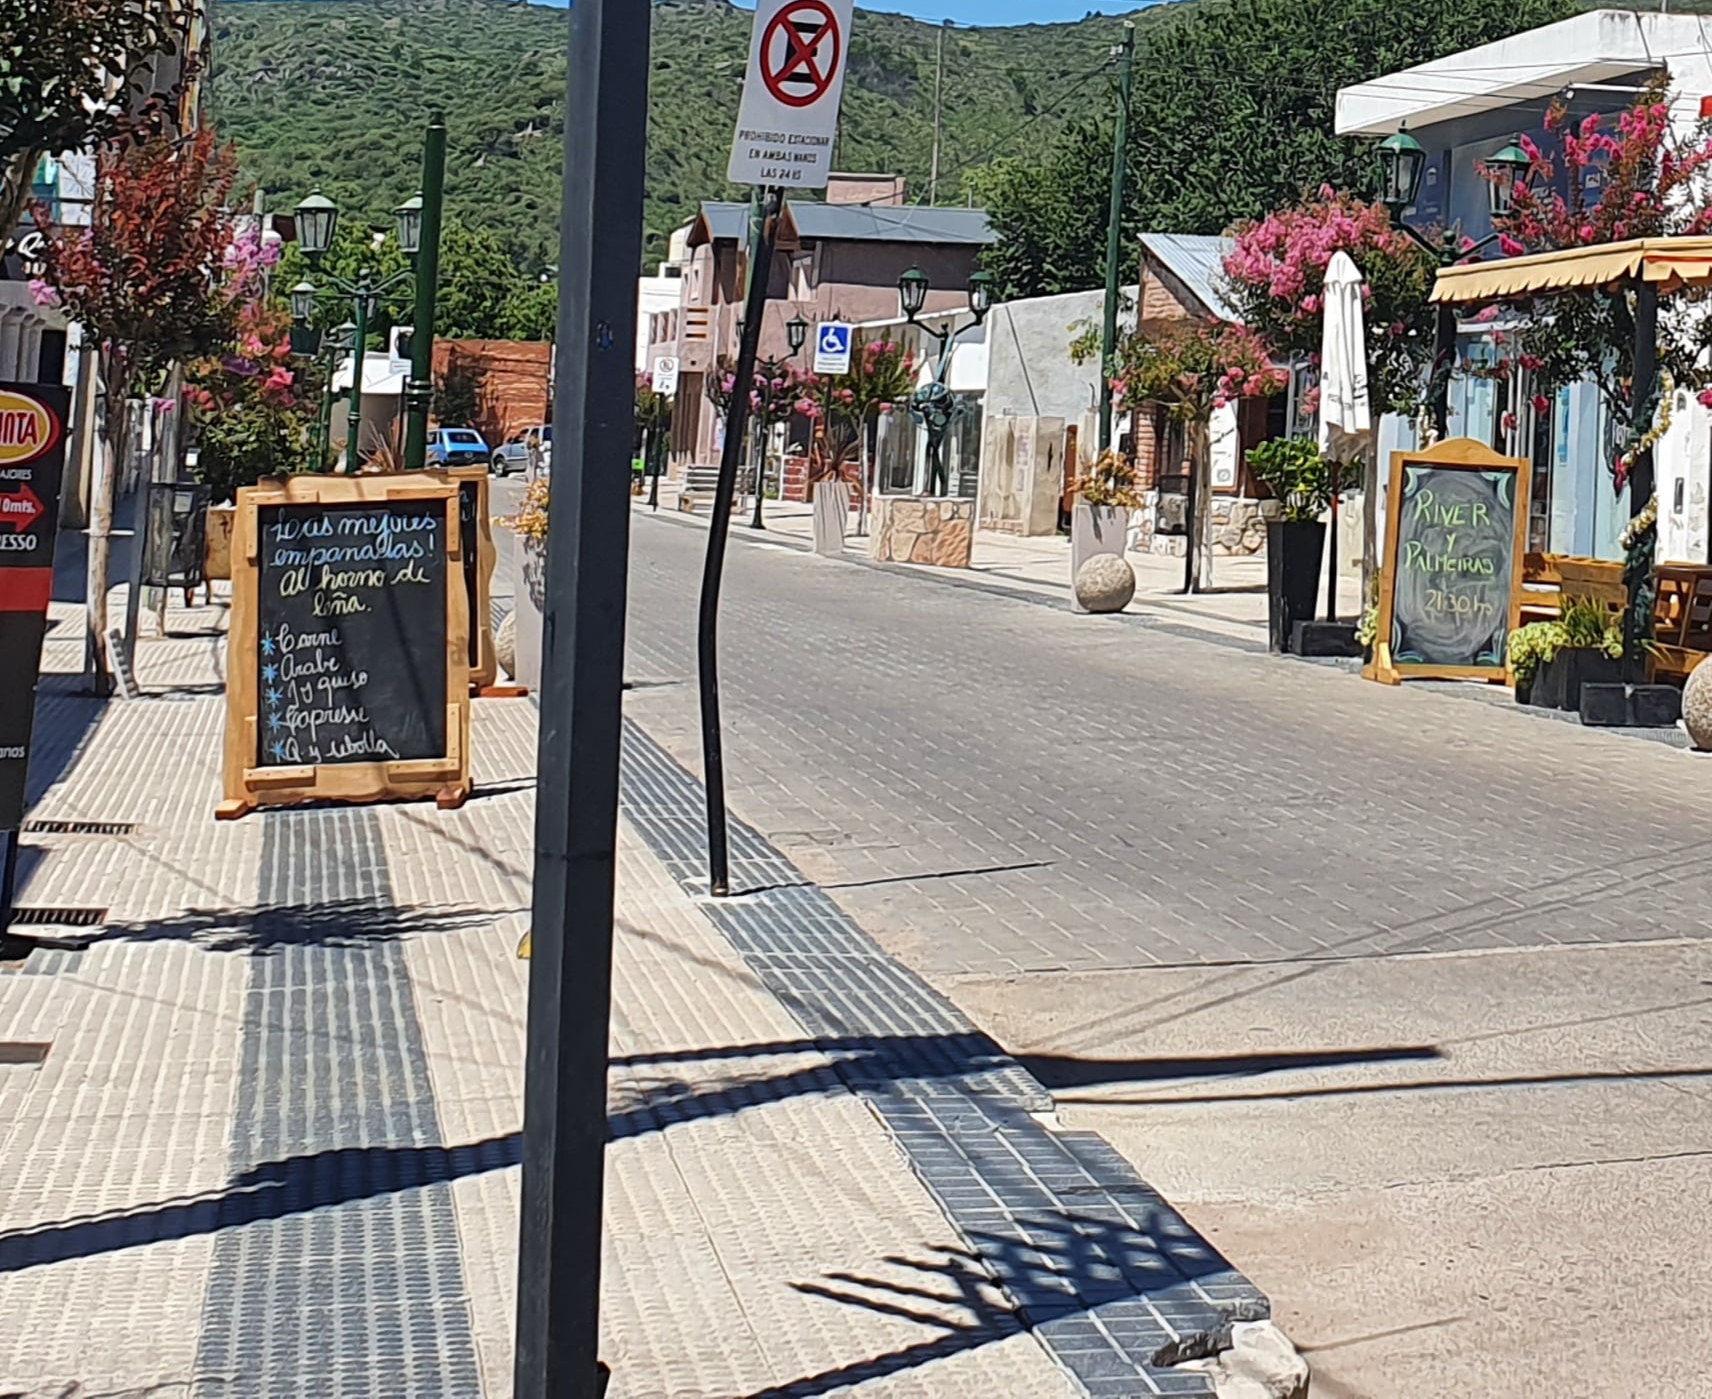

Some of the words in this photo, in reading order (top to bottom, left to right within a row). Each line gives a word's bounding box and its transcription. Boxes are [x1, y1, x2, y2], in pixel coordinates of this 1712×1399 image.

[748, 148, 760, 159] EN
[761, 167, 777, 178] LAS
[1414, 488, 1490, 527] RIVER
[314, 563, 386, 591] horno
[389, 558, 431, 585] de
[275, 623, 343, 653] Carne
